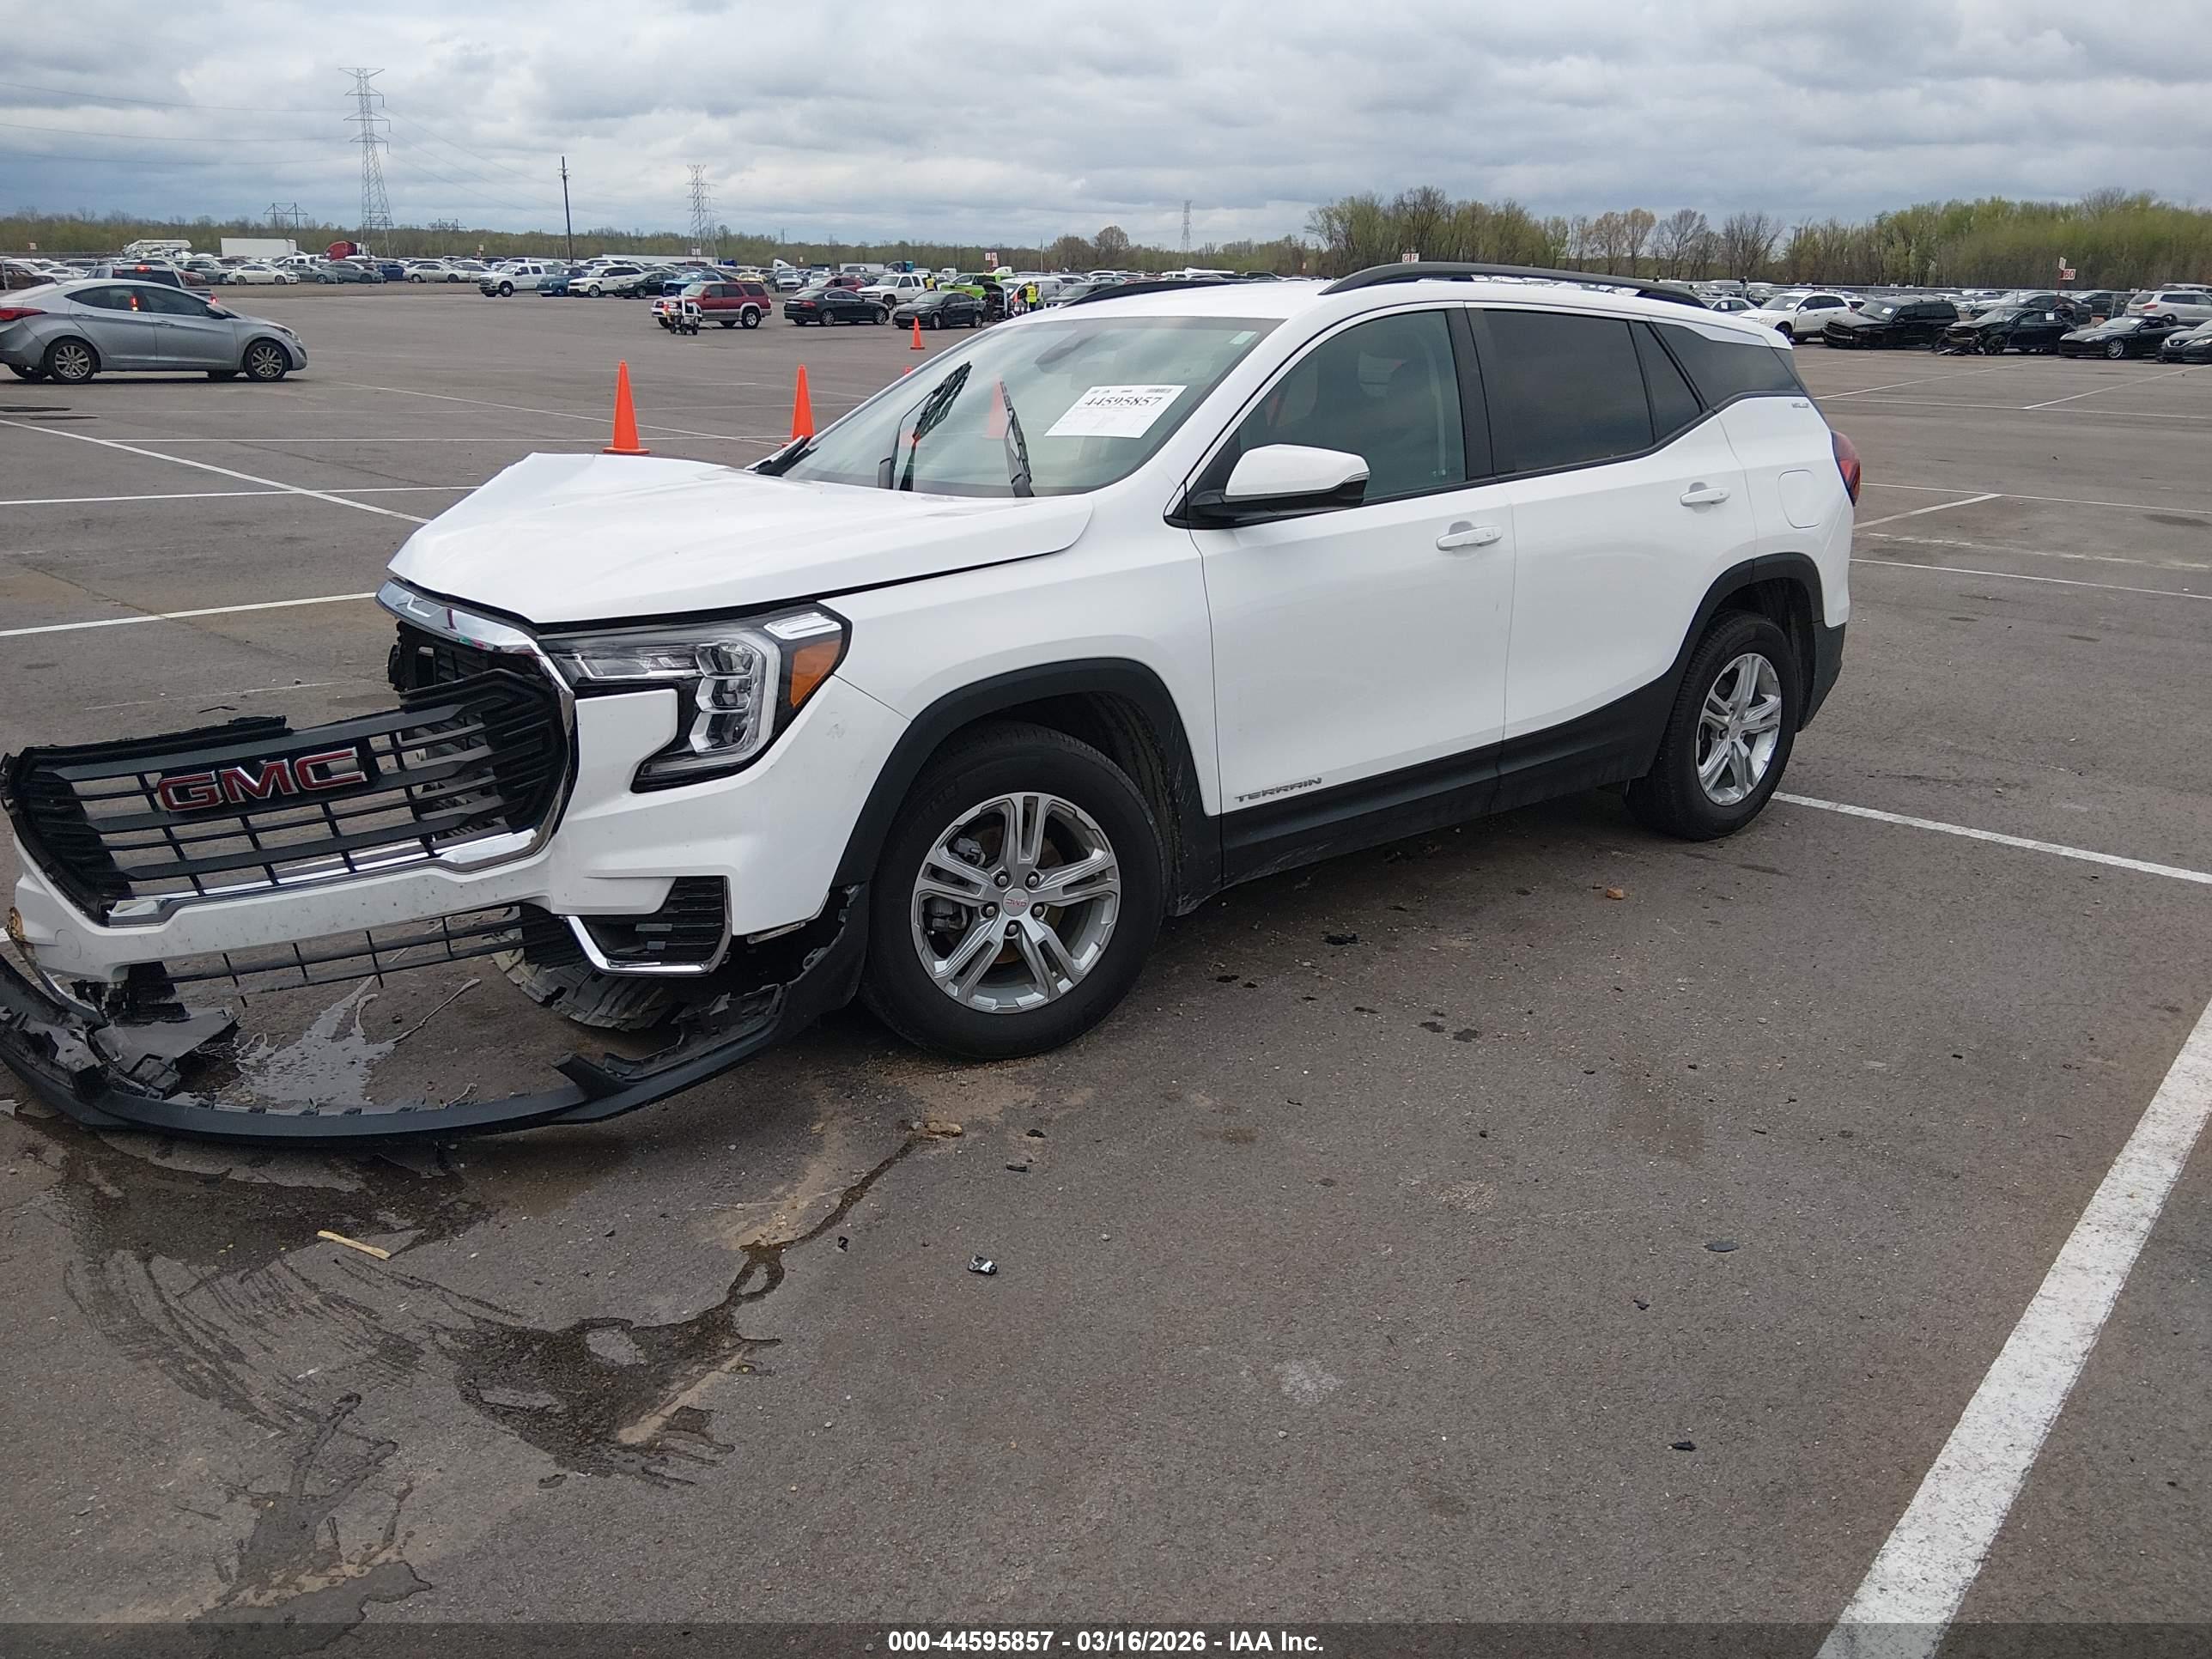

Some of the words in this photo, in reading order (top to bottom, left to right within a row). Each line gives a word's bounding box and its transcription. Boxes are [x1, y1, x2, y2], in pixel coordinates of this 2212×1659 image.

[2064, 270, 2075, 278] 60
[1085, 397, 1164, 406] 44595857
[157, 746, 368, 811] GMC
[1234, 777, 1322, 803] TERRAIN
